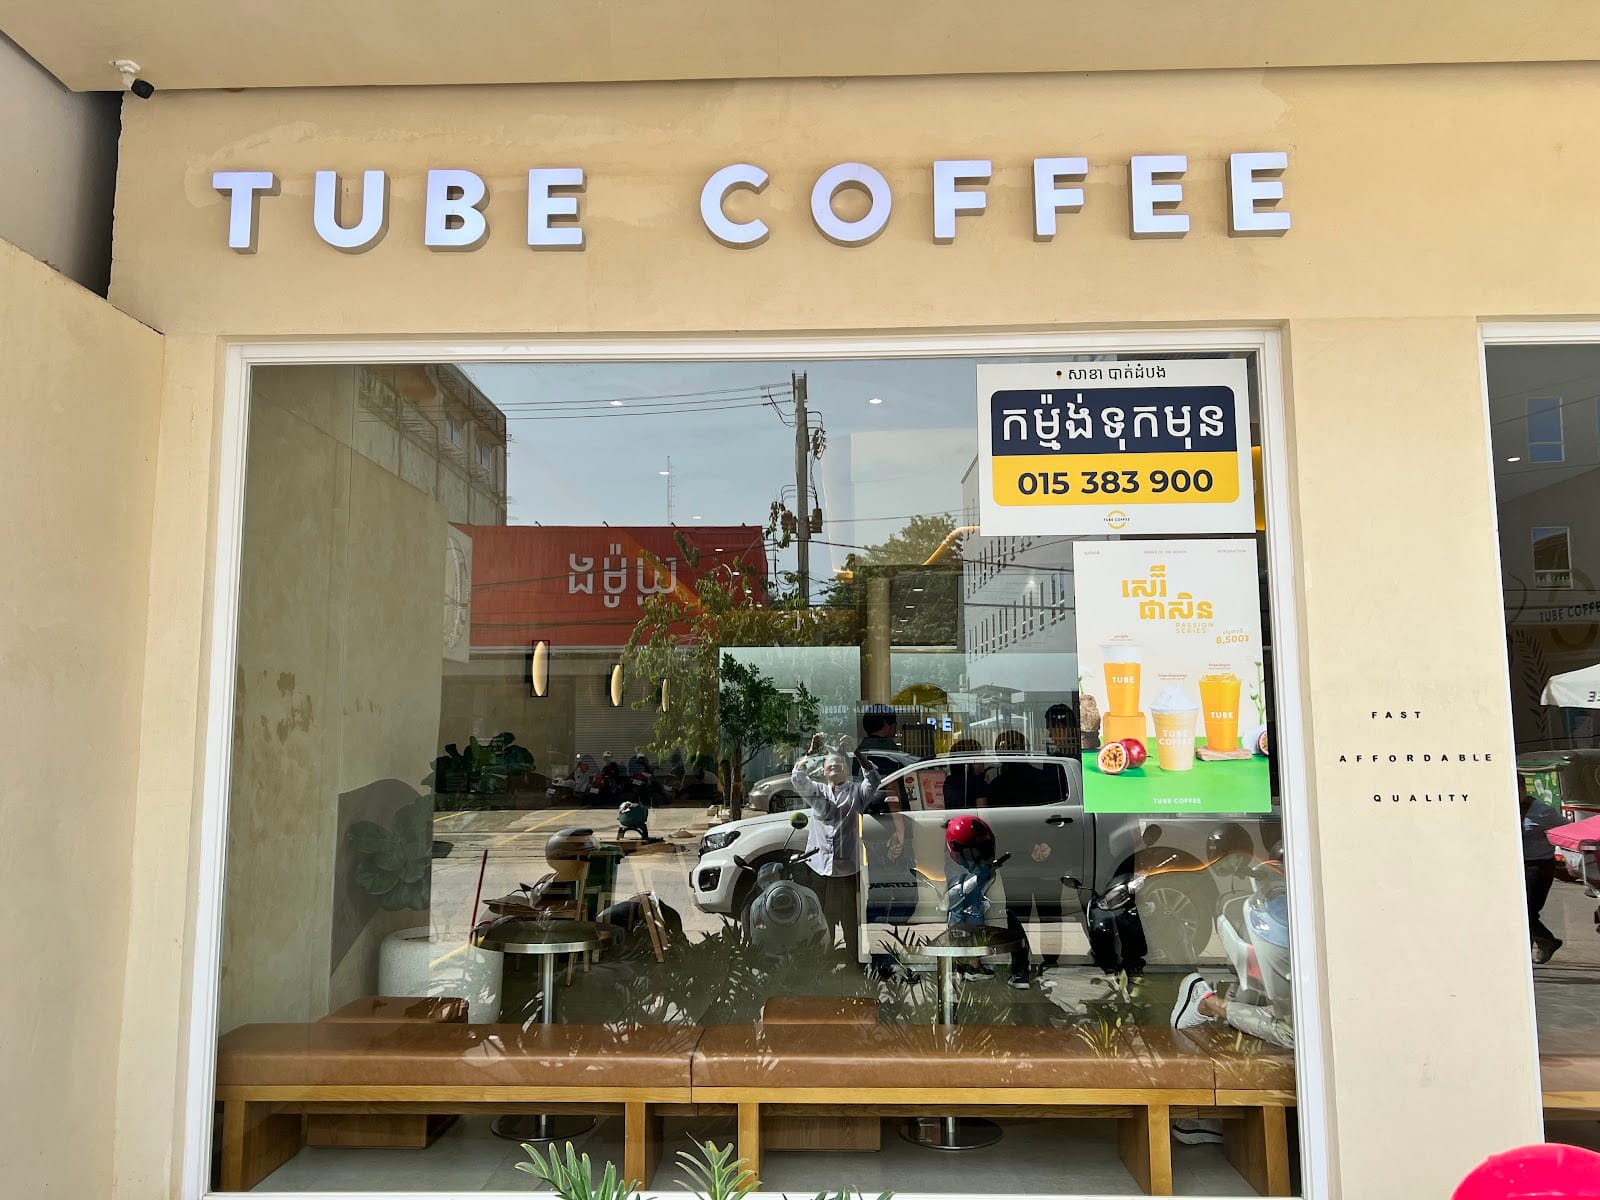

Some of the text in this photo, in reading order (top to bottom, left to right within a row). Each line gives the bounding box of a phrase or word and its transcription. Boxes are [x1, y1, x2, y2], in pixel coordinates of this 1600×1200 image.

[212, 152, 1291, 254] TUBE COFFEE
[1068, 363, 1166, 380] សាខា បាត់ដំបង
[1018, 469, 1213, 495] 015 383 900
[1538, 608, 1563, 624] TUBE
[1111, 676, 1135, 684] TUBE
[1210, 711, 1234, 719] TUBE
[1371, 711, 1421, 719] FAST
[1339, 753, 1492, 763] AFFORDABLE
[1373, 794, 1469, 803] QUALITY
